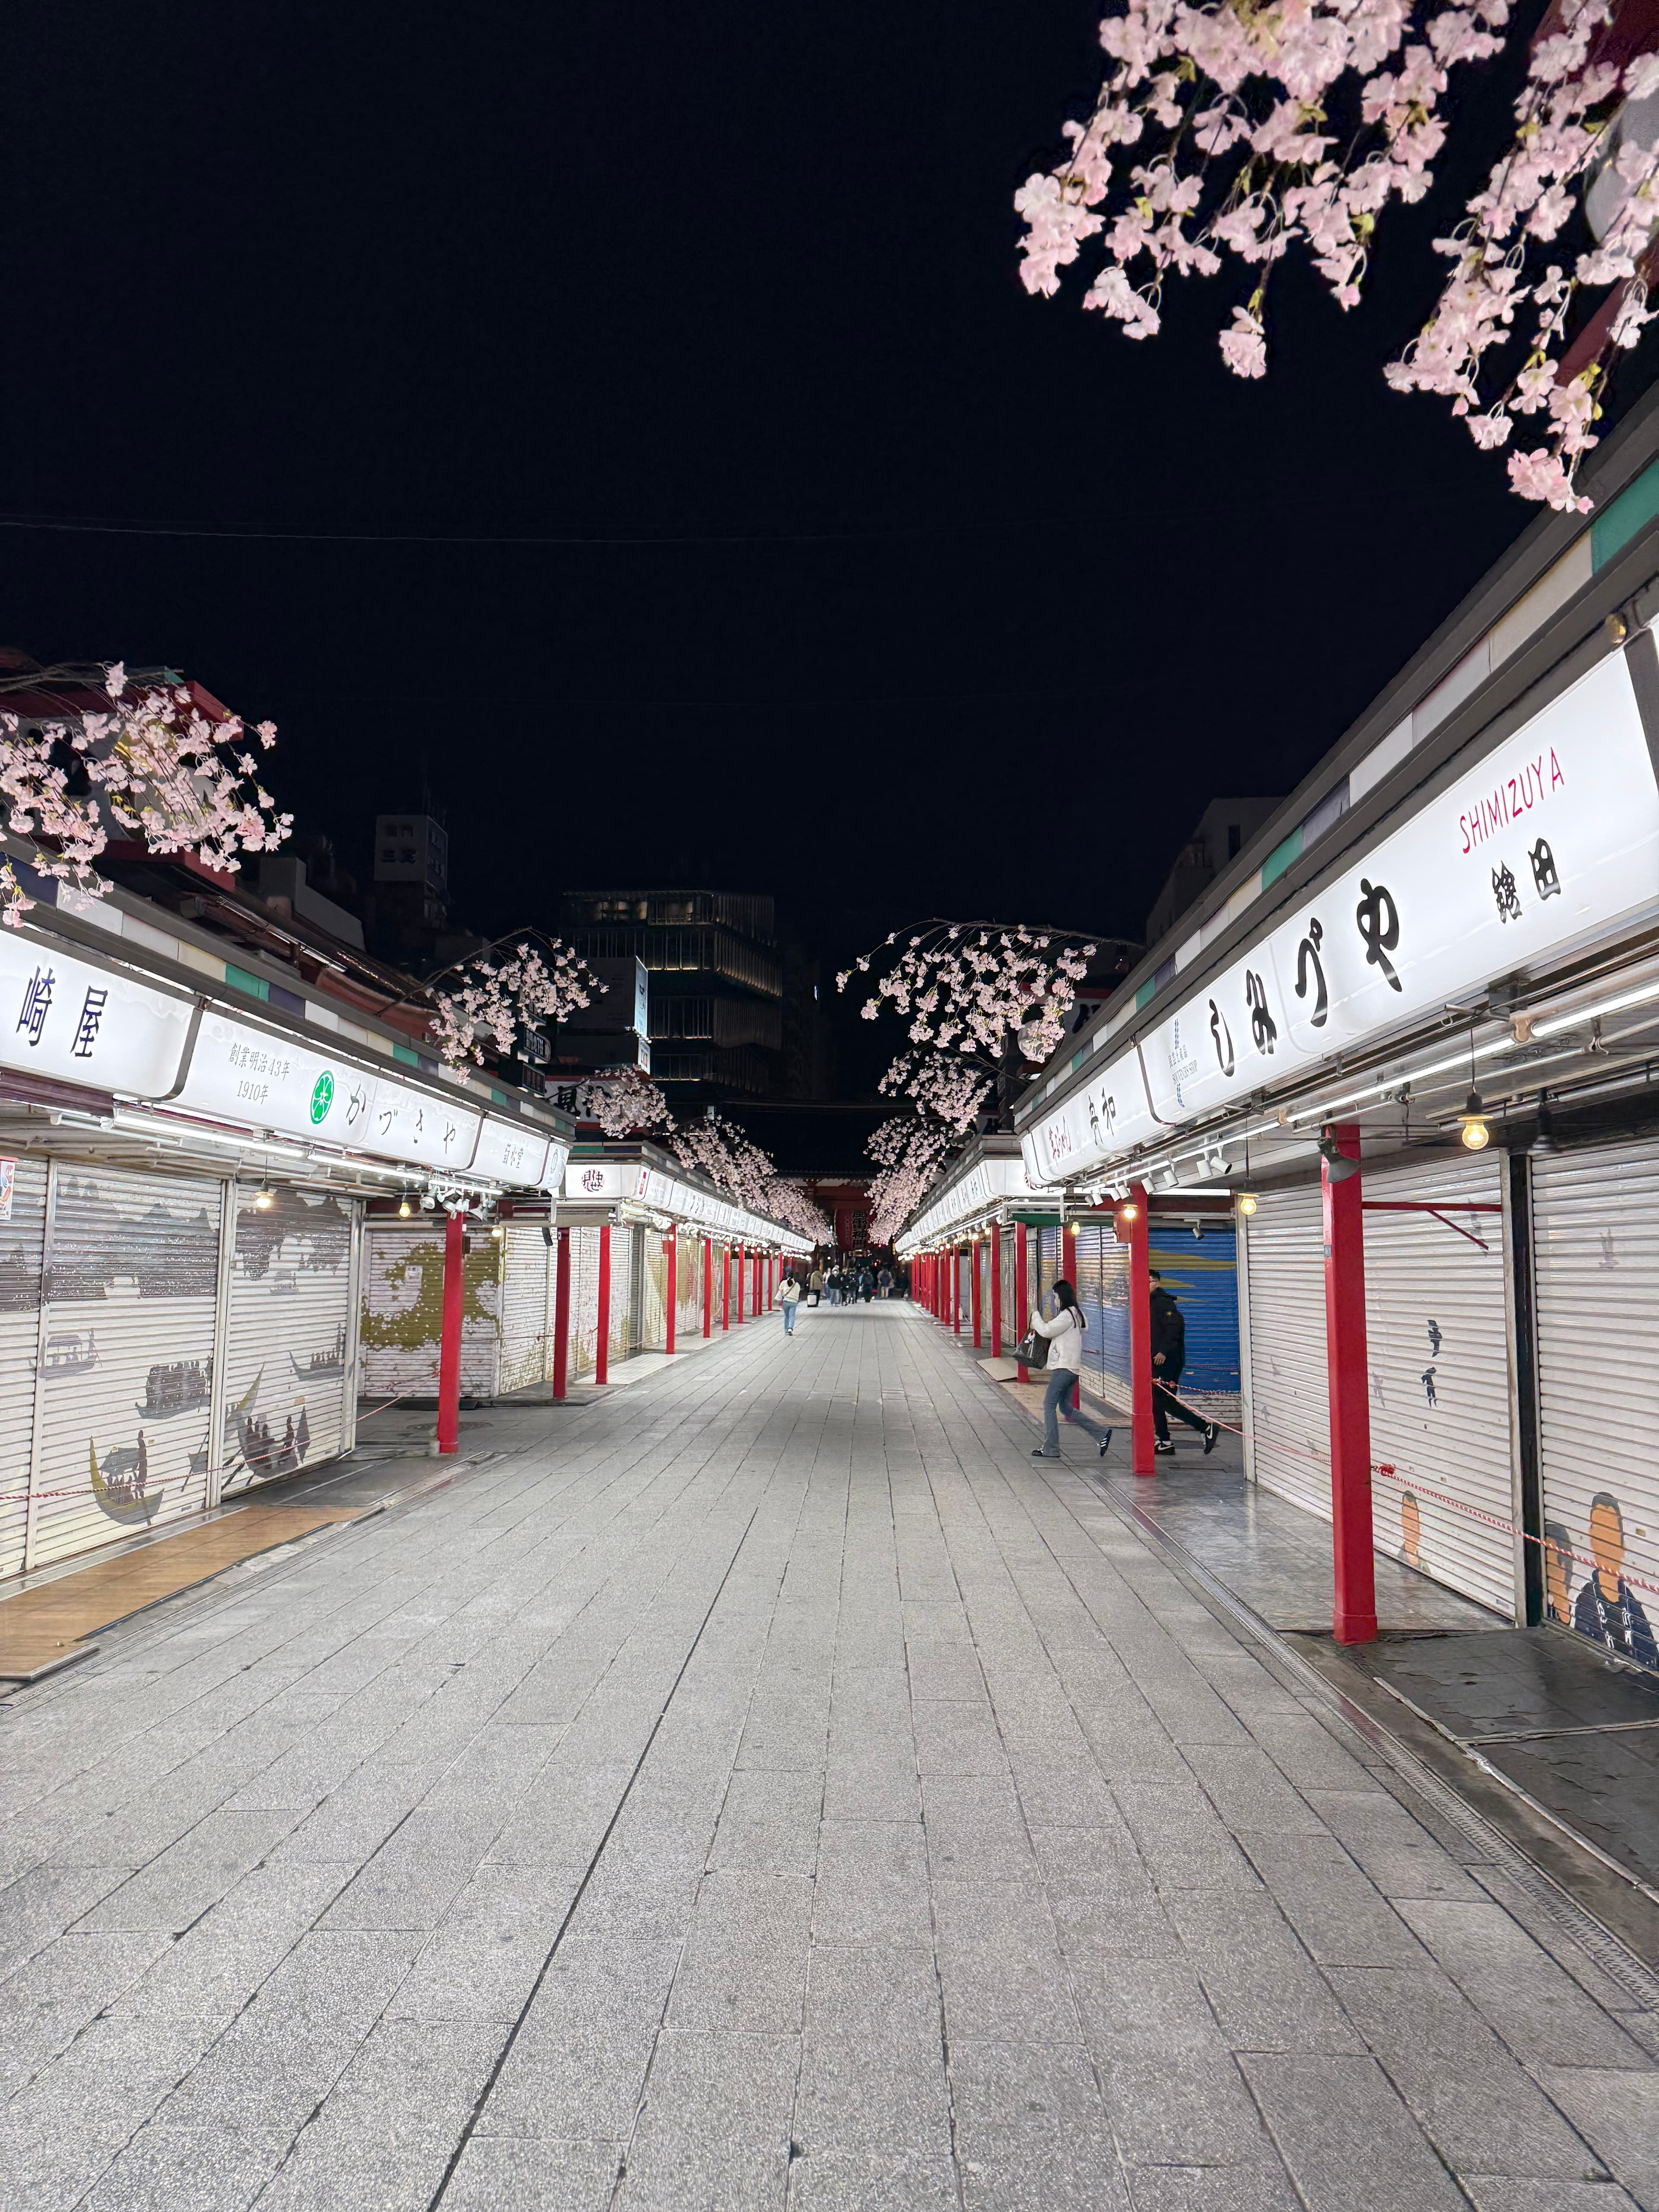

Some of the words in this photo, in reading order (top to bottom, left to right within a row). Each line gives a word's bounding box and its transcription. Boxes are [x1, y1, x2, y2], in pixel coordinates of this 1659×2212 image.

[1459, 747, 1565, 854] SHIMIZUYA
[16, 965, 108, 1057] 崎屋
[1209, 878, 1402, 1077] しみづや
[229, 1043, 290, 1081] 創業明治43年
[237, 1081, 269, 1104] 1910年
